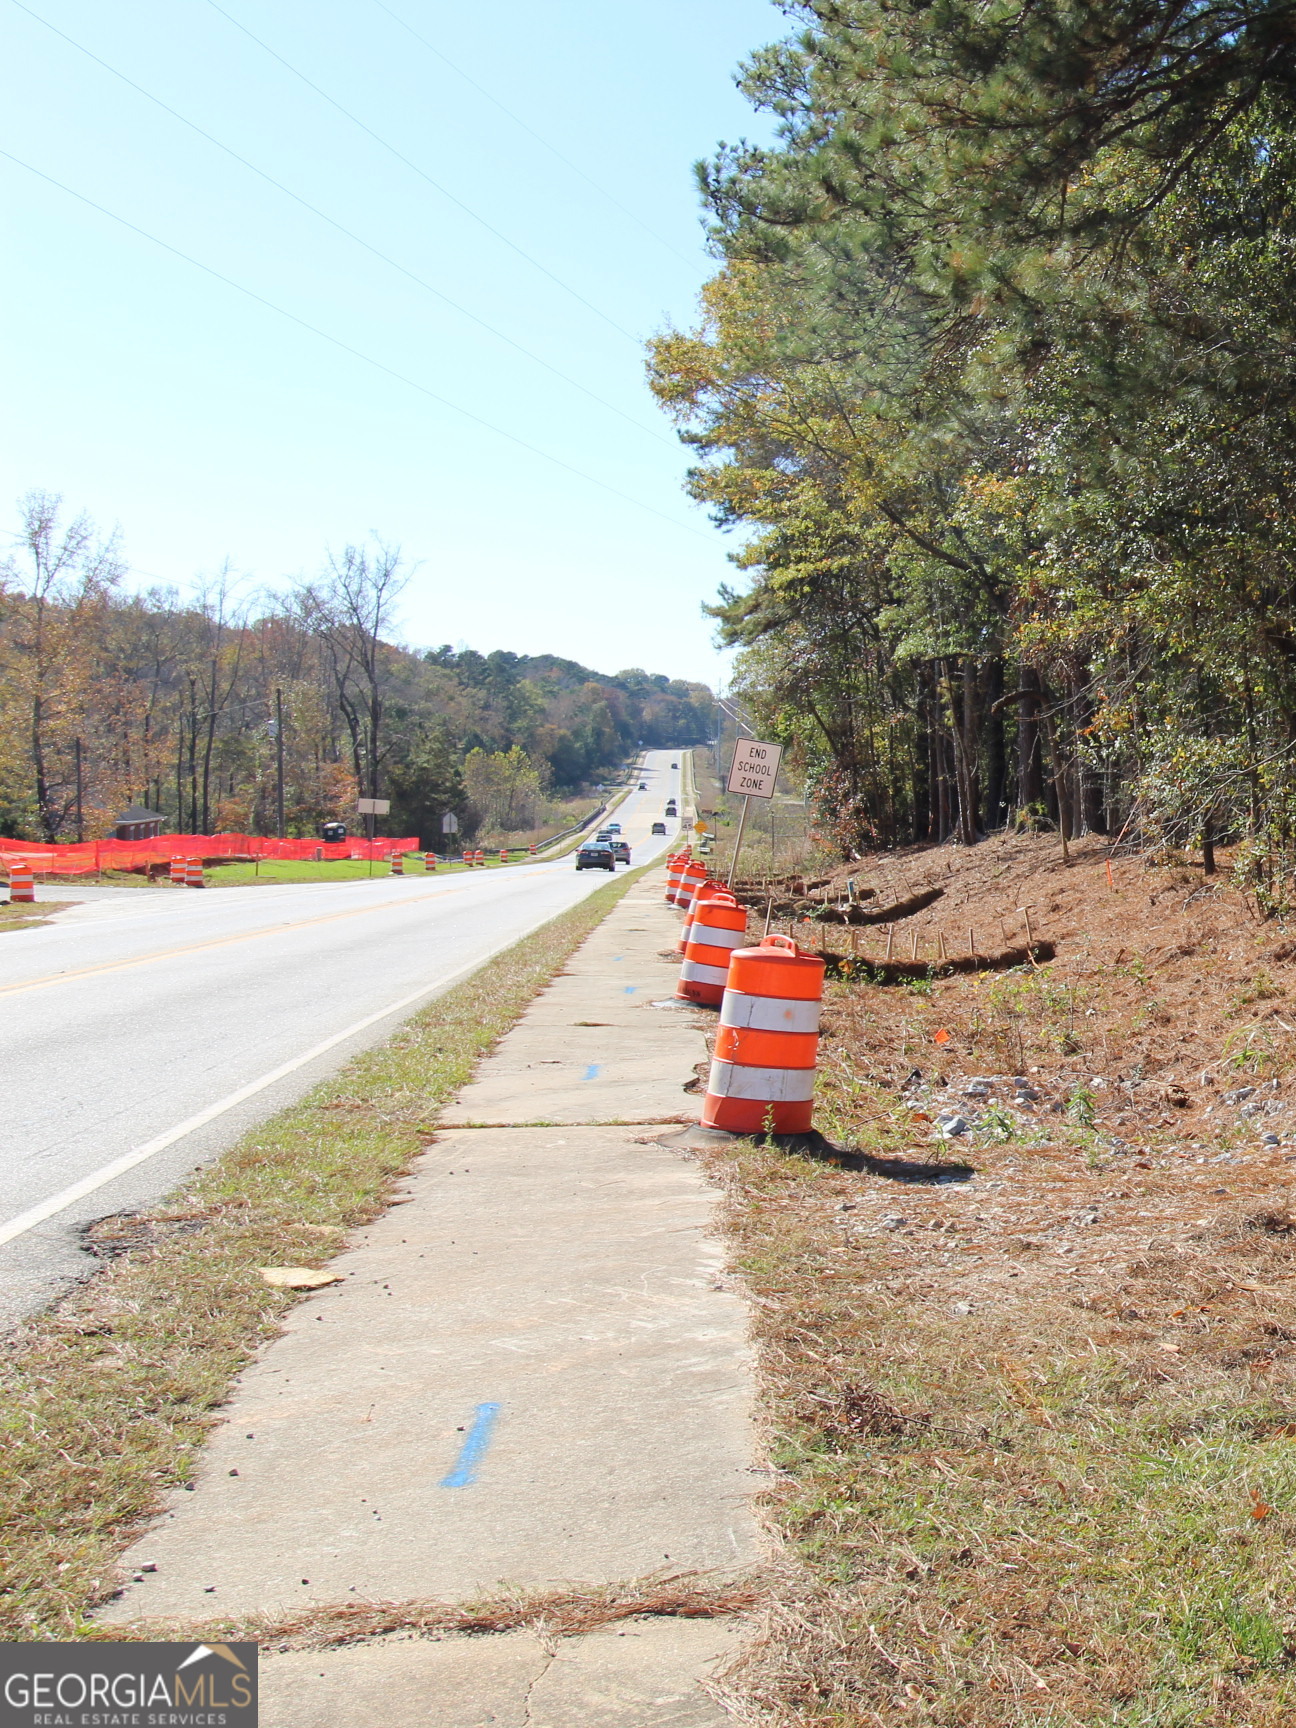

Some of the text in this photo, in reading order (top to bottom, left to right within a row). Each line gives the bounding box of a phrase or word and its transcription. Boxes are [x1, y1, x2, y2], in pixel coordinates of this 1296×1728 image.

[749, 747, 767, 759] END
[737, 761, 771, 776] SCHOOL
[740, 777, 764, 790] ZONE
